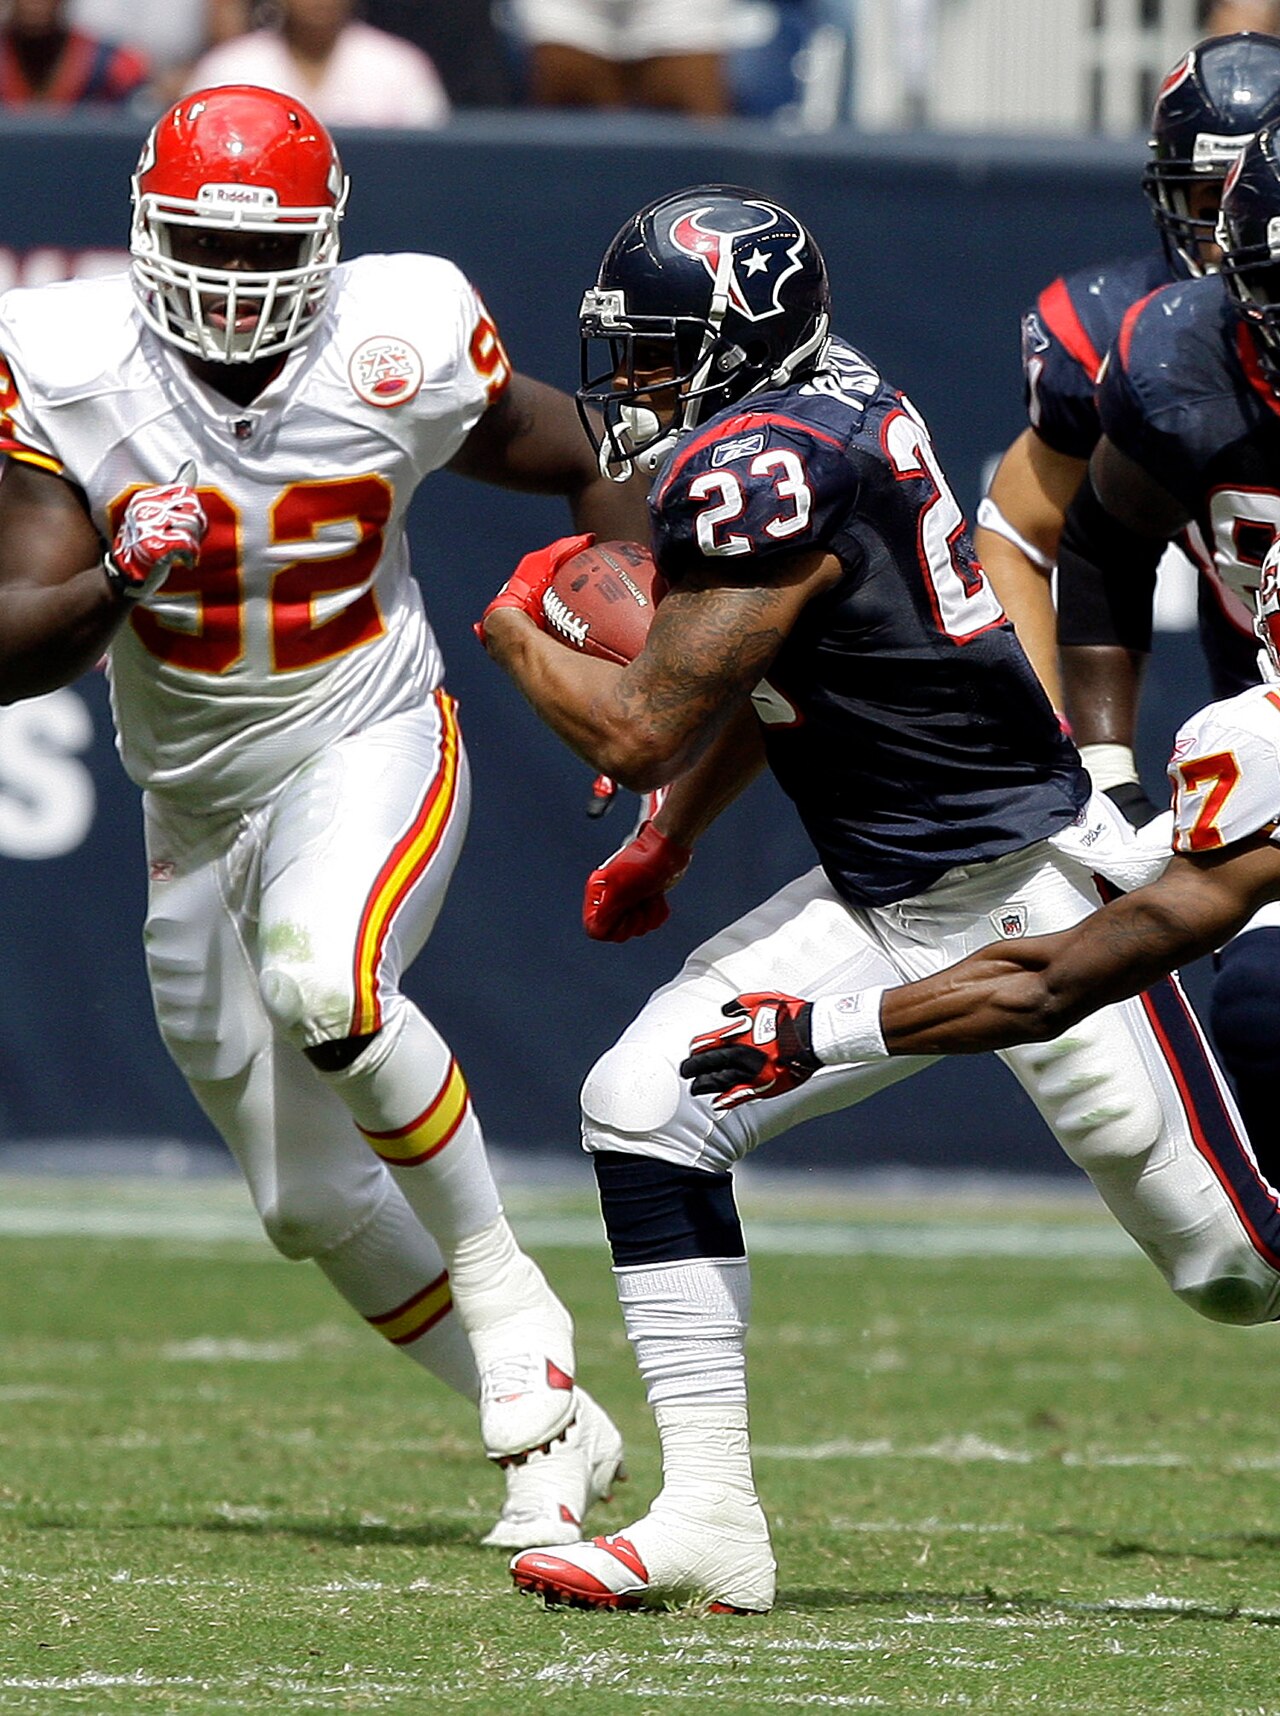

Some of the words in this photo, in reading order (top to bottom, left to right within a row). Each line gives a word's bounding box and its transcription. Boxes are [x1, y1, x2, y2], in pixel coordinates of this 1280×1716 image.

[217, 189, 260, 203] Riddell
[688, 446, 813, 558] 23
[106, 472, 395, 675] 92
[1169, 749, 1243, 852] 7
